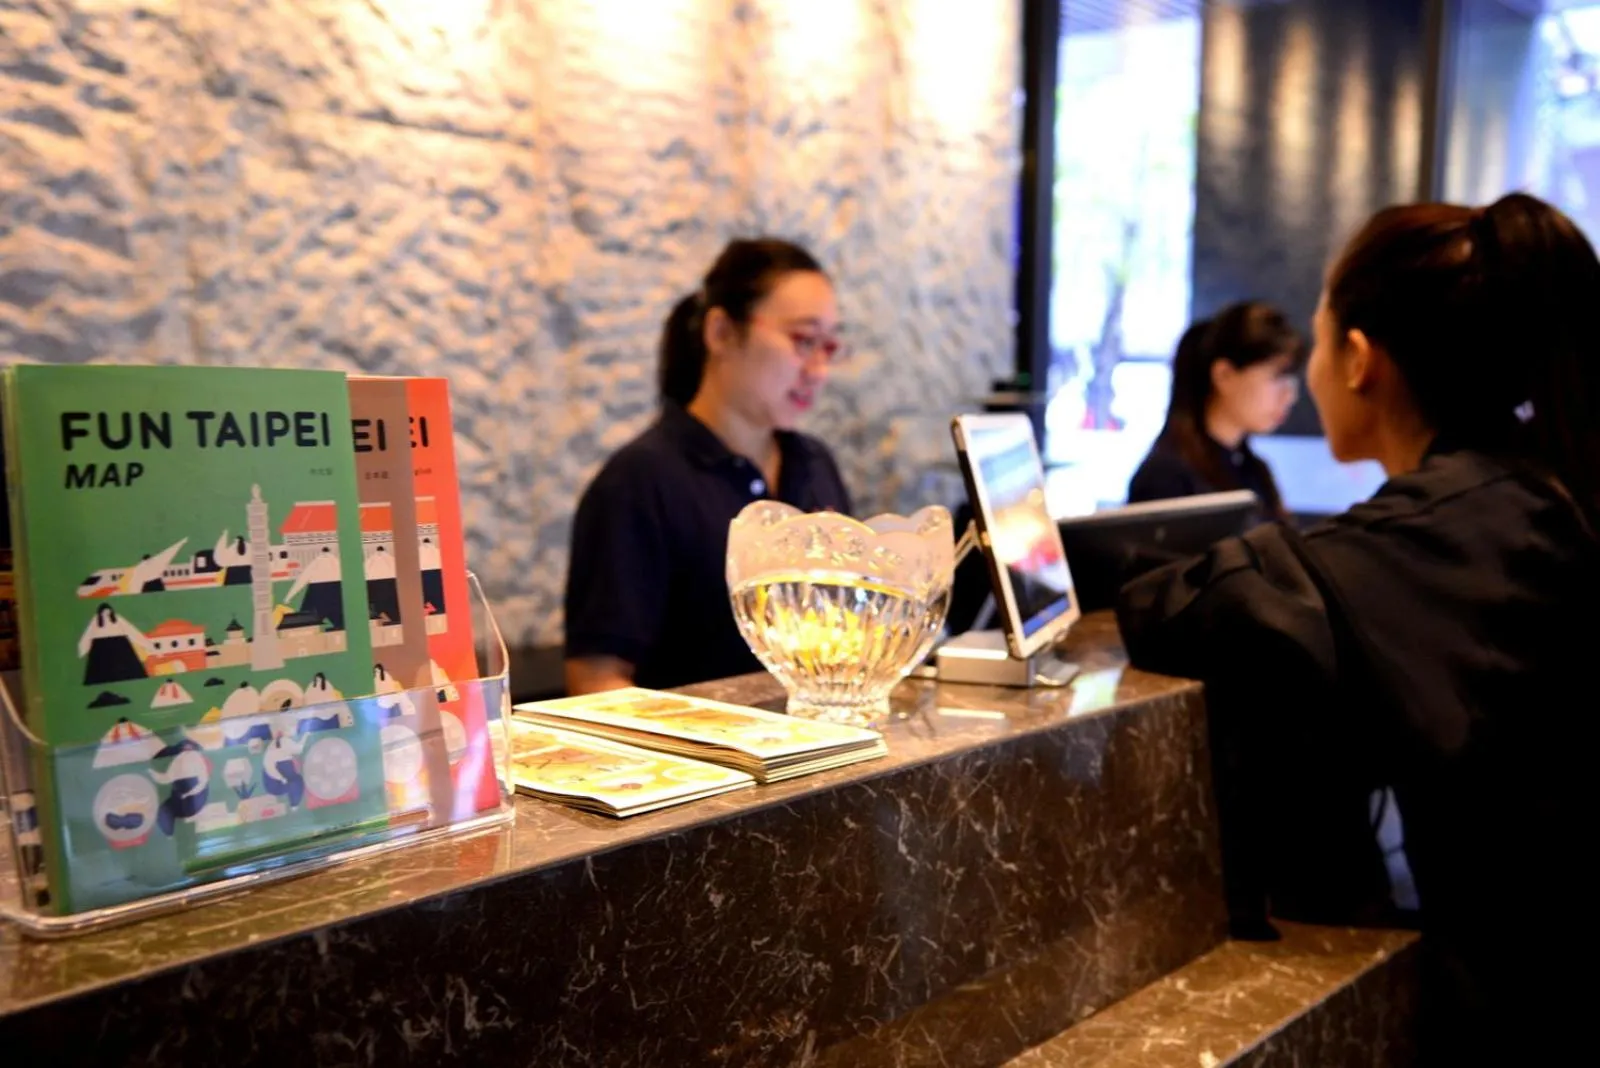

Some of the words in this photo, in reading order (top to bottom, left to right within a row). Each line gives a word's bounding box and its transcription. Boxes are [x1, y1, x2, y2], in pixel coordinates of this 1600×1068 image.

[60, 411, 172, 452] FUN
[186, 411, 330, 448] TAIPEI
[64, 463, 145, 490] MAP
